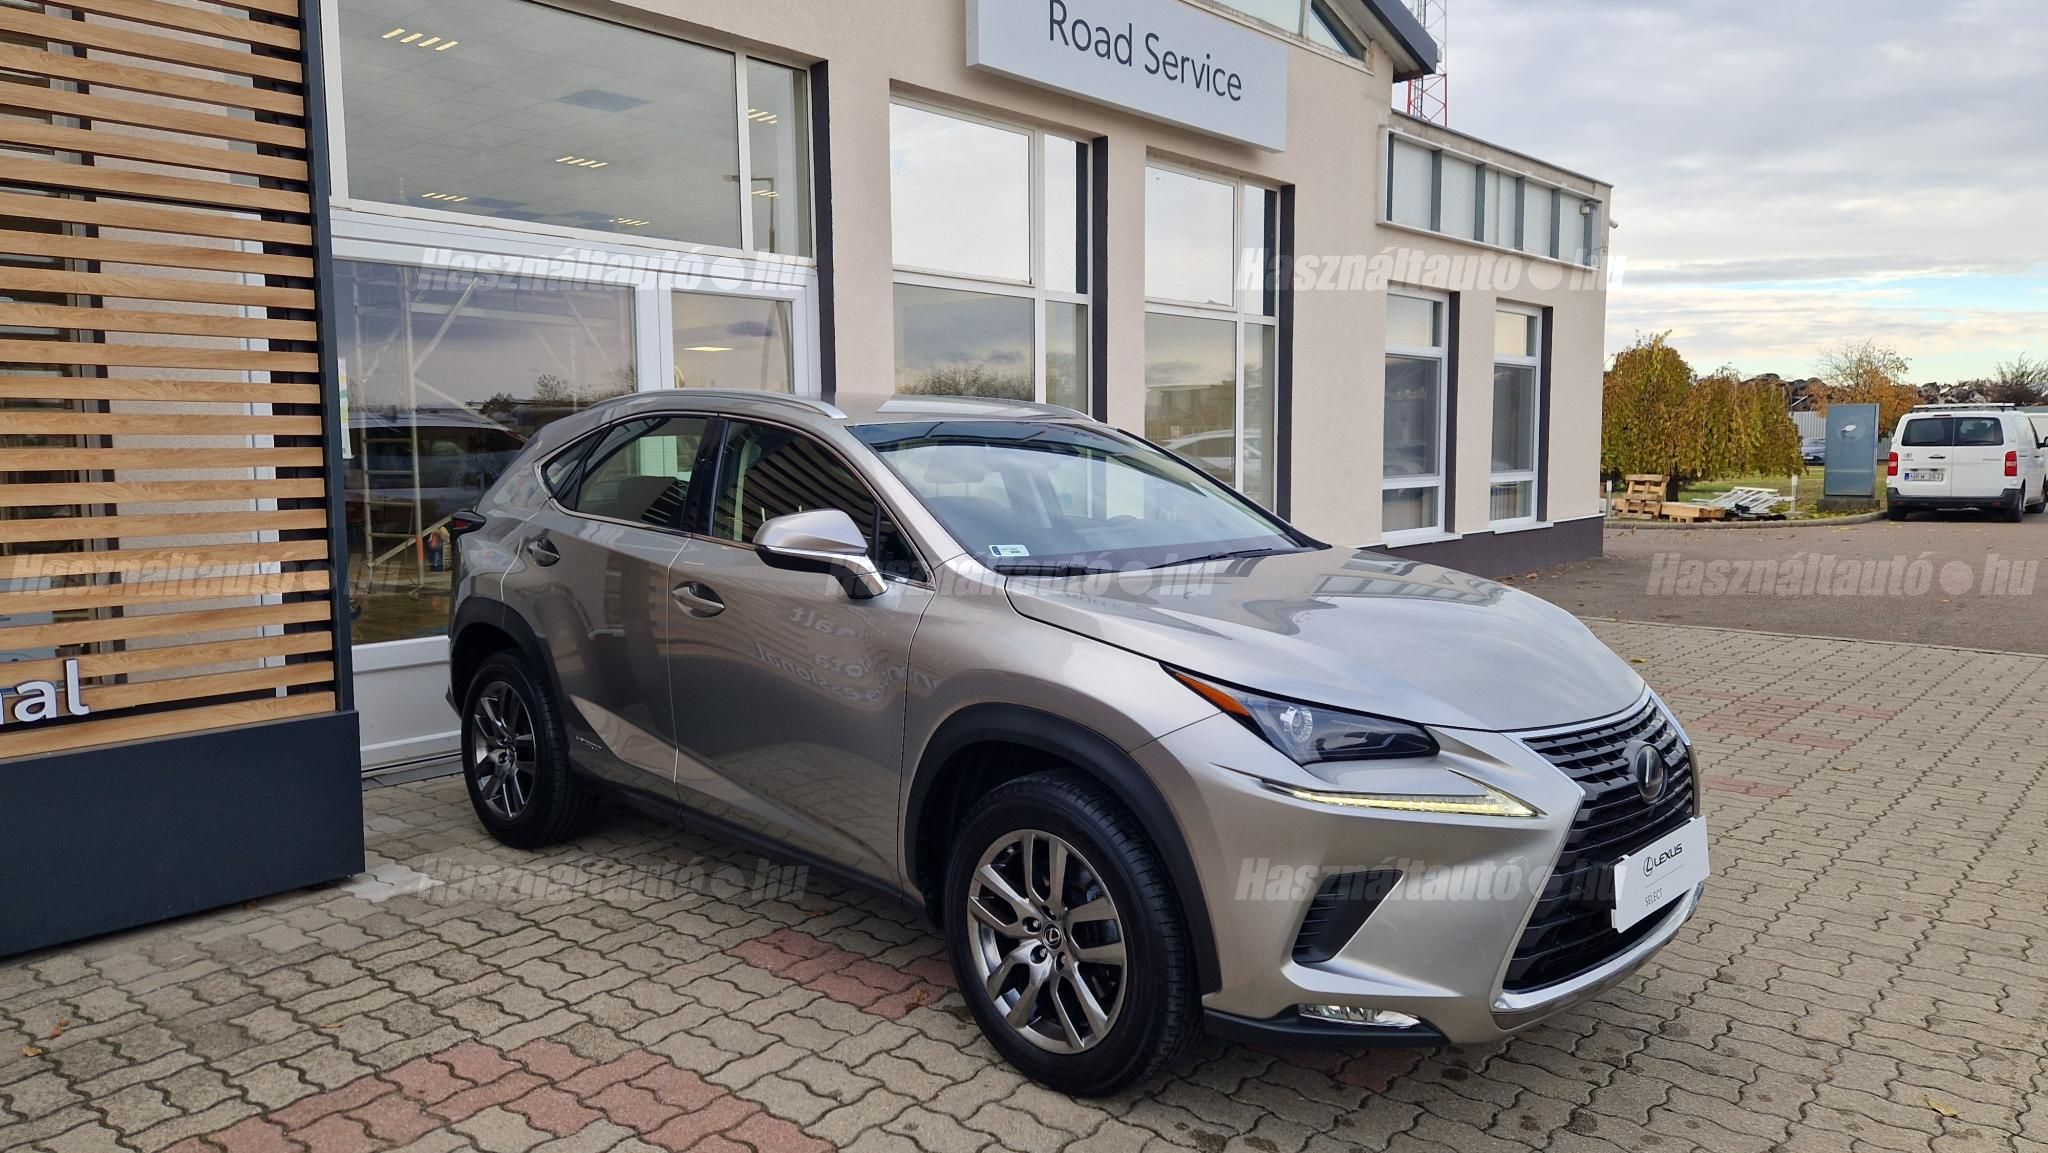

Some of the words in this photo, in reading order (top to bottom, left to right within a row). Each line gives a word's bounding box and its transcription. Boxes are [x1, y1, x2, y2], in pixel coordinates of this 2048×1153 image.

[1049, 0, 1133, 67] Road
[1144, 32, 1242, 102] Service
[0, 659, 90, 725] al
[1653, 843, 1683, 867] LEXUS
[1644, 888, 1663, 907] SELECT
